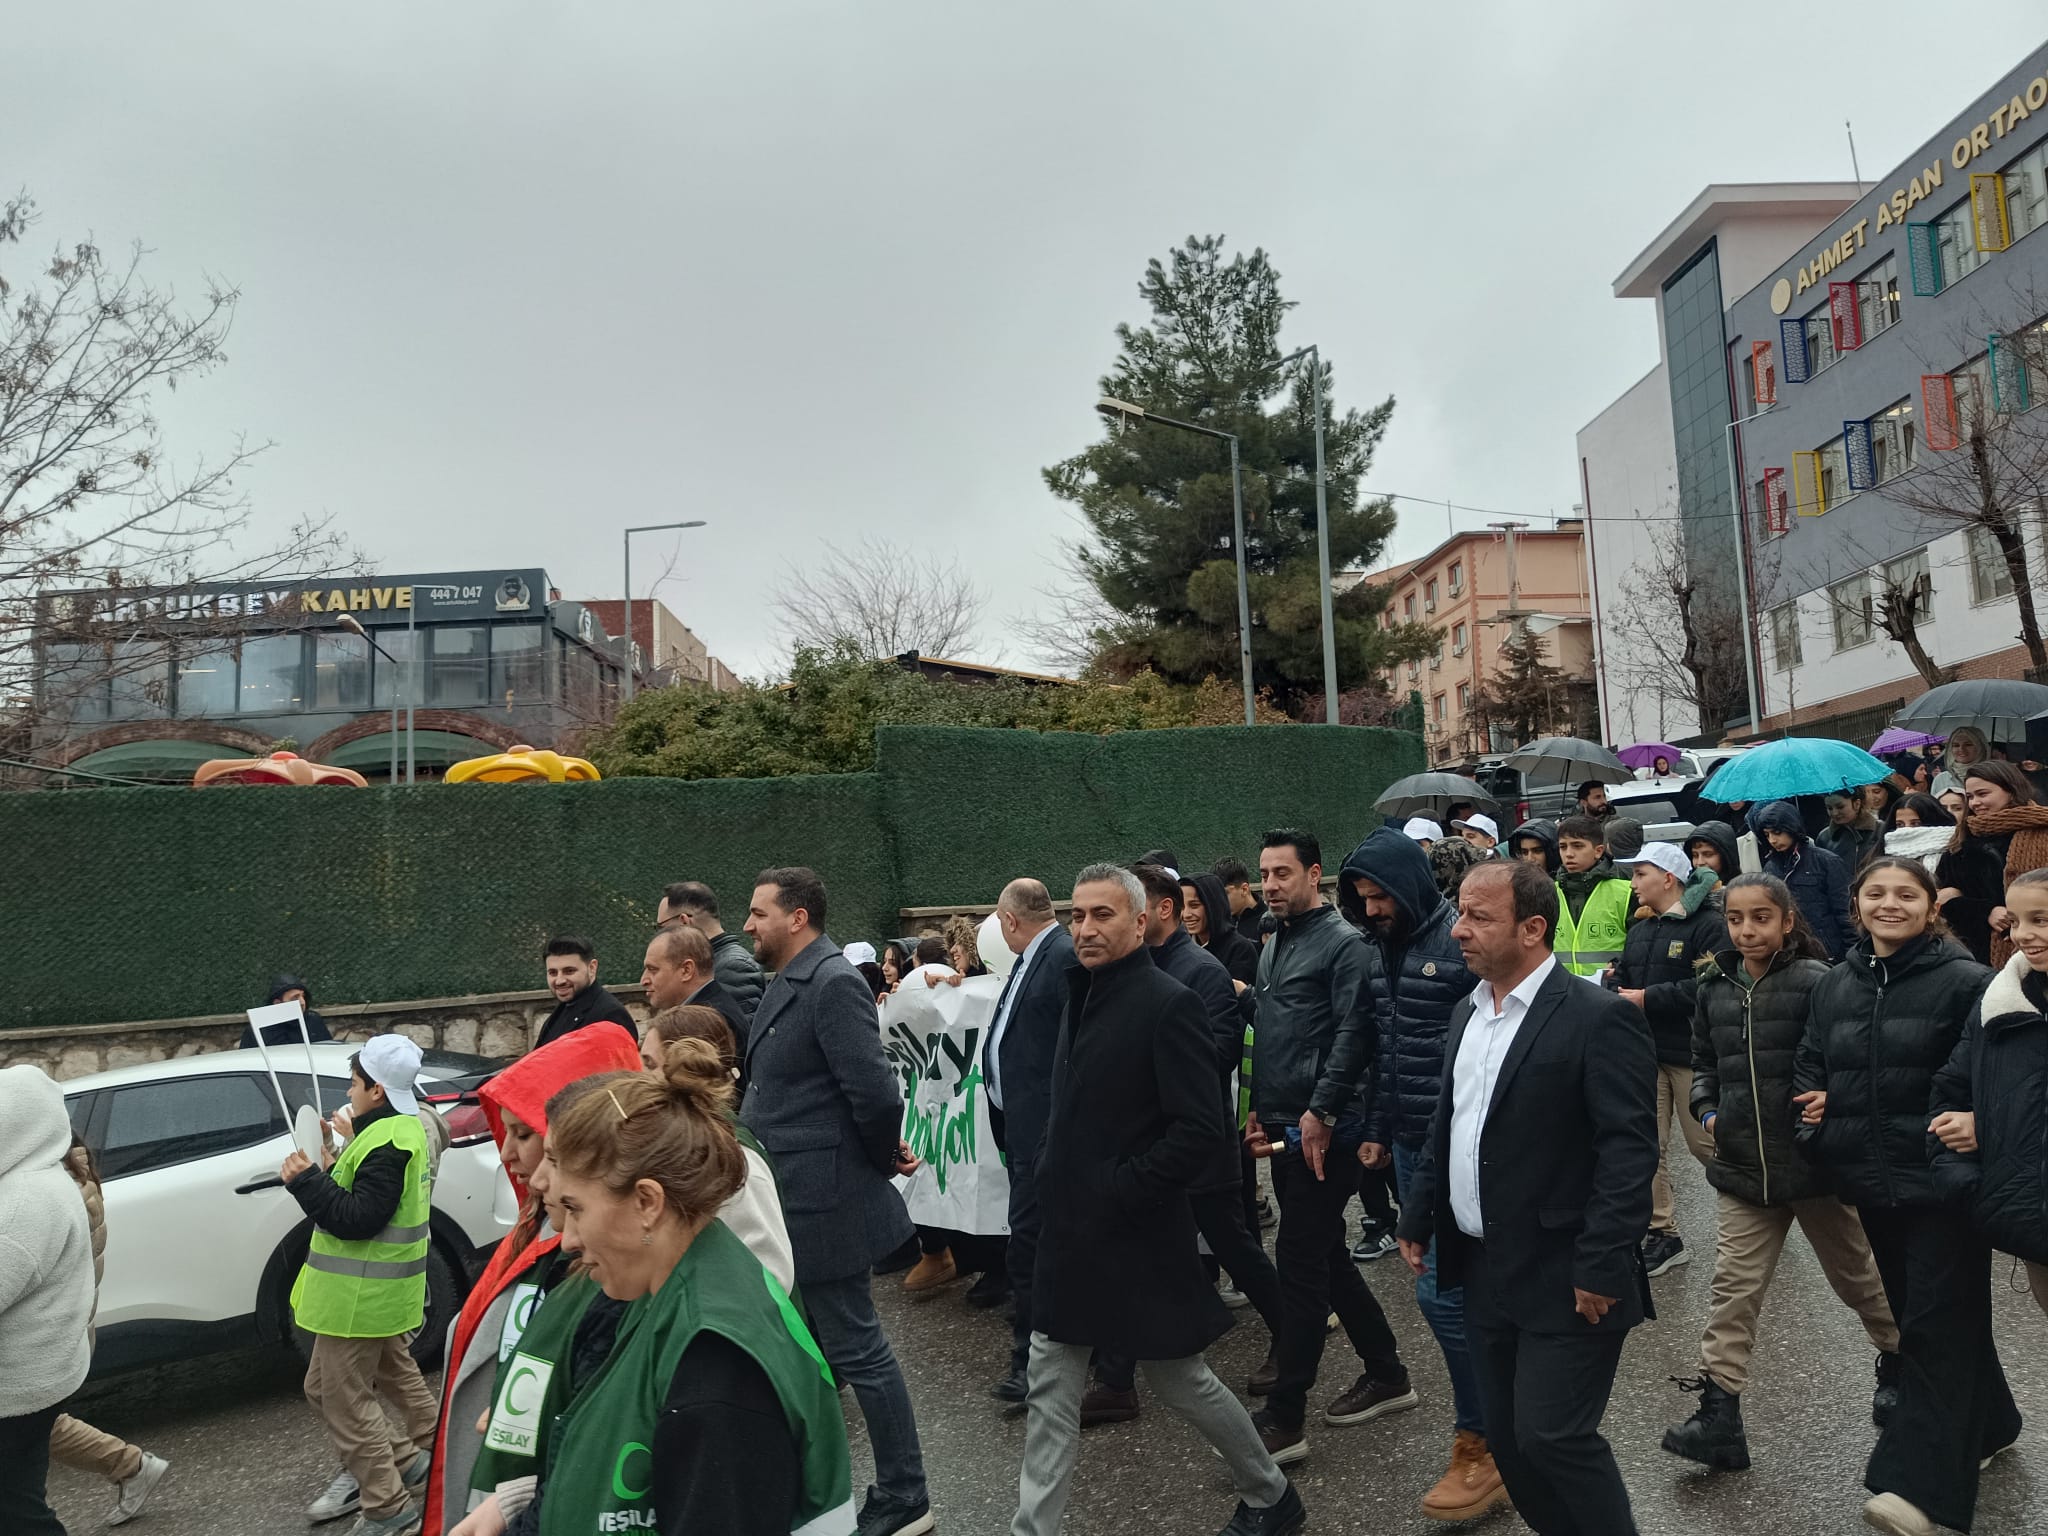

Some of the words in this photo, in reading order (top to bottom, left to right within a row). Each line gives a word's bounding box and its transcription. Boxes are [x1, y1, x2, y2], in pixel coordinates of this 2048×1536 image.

[1797, 217, 1869, 295] AHMET
[1875, 158, 1943, 234] AŞAN
[1951, 70, 2048, 169] ORTAO
[301, 586, 412, 613] KAHVE
[430, 588, 450, 600] 444
[462, 585, 483, 599] 047
